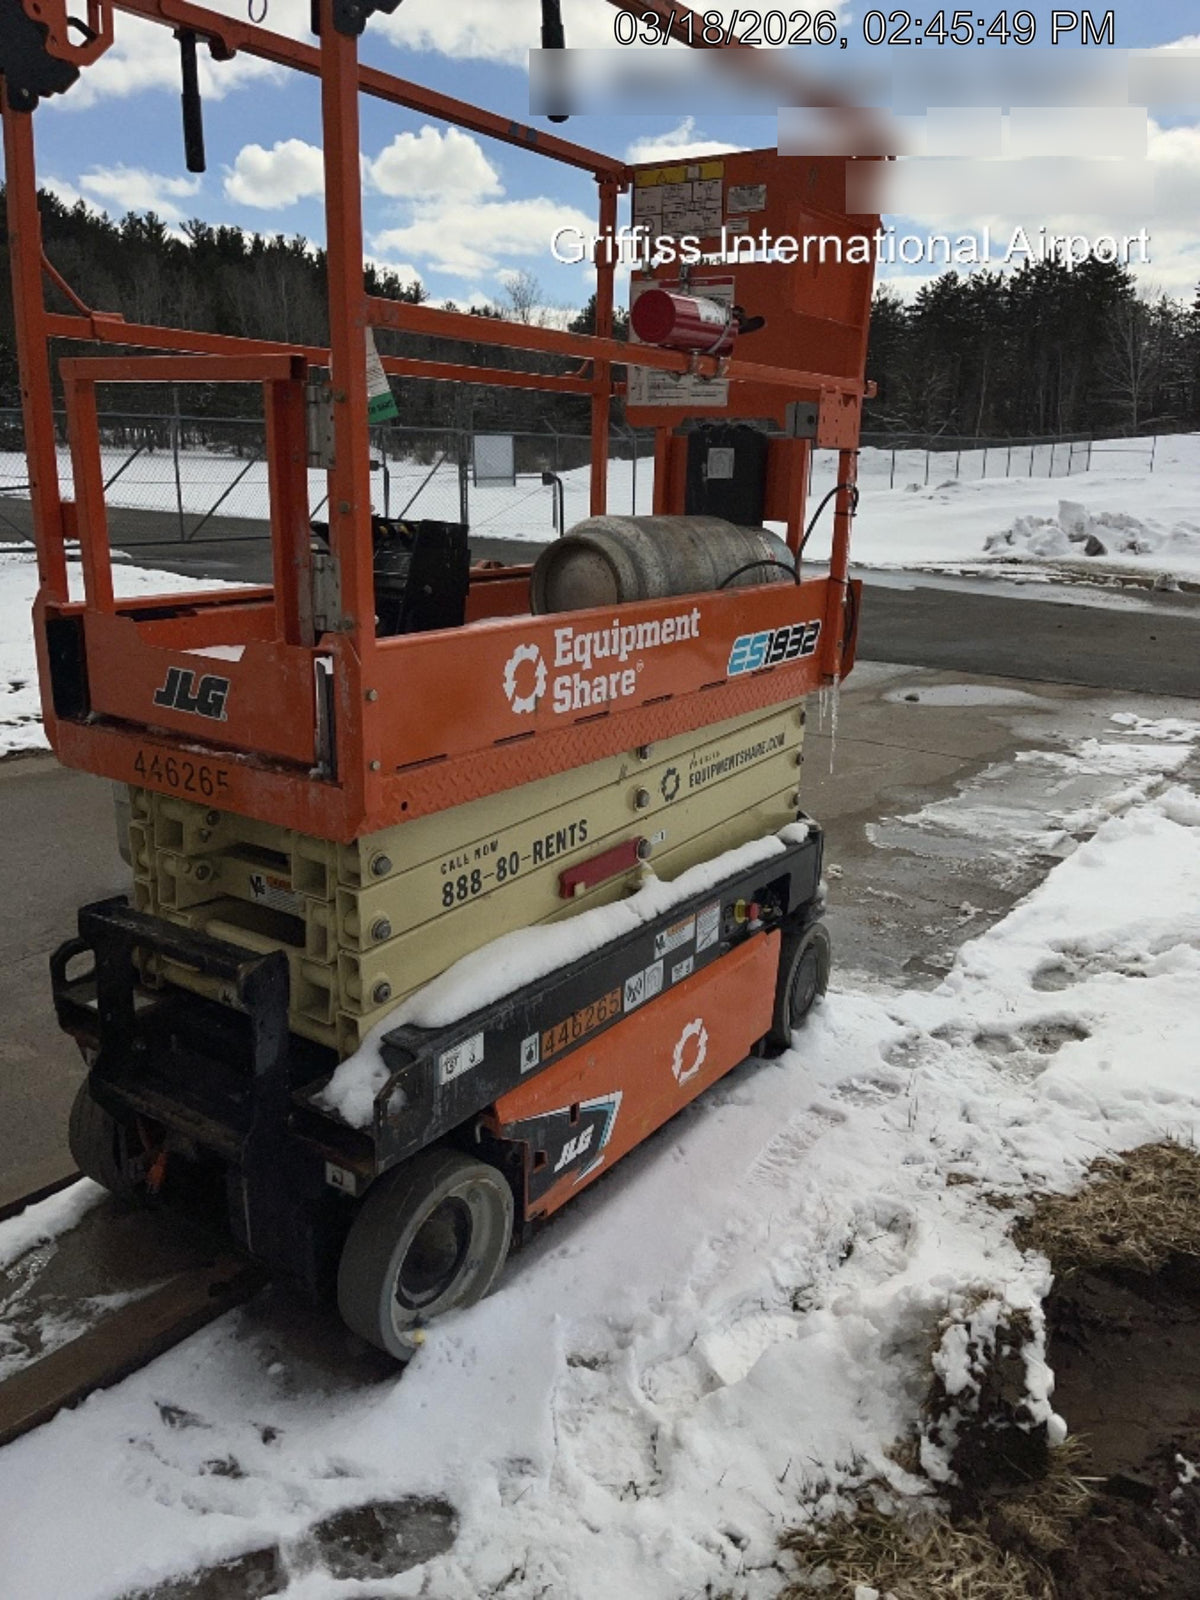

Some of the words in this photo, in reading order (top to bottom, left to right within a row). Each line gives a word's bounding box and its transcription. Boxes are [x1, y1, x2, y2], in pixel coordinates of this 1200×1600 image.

[554, 607, 701, 670] Equipment
[727, 619, 822, 676] ES1932
[153, 666, 230, 722] JLG
[689, 732, 785, 788] EQUIPMENTSHARE.COM
[440, 855, 470, 875] CALL
[474, 840, 499, 861] NOW
[442, 819, 588, 907] 888-80-RENTS
[544, 989, 621, 1053] 446265
[553, 1124, 595, 1173] JLG
